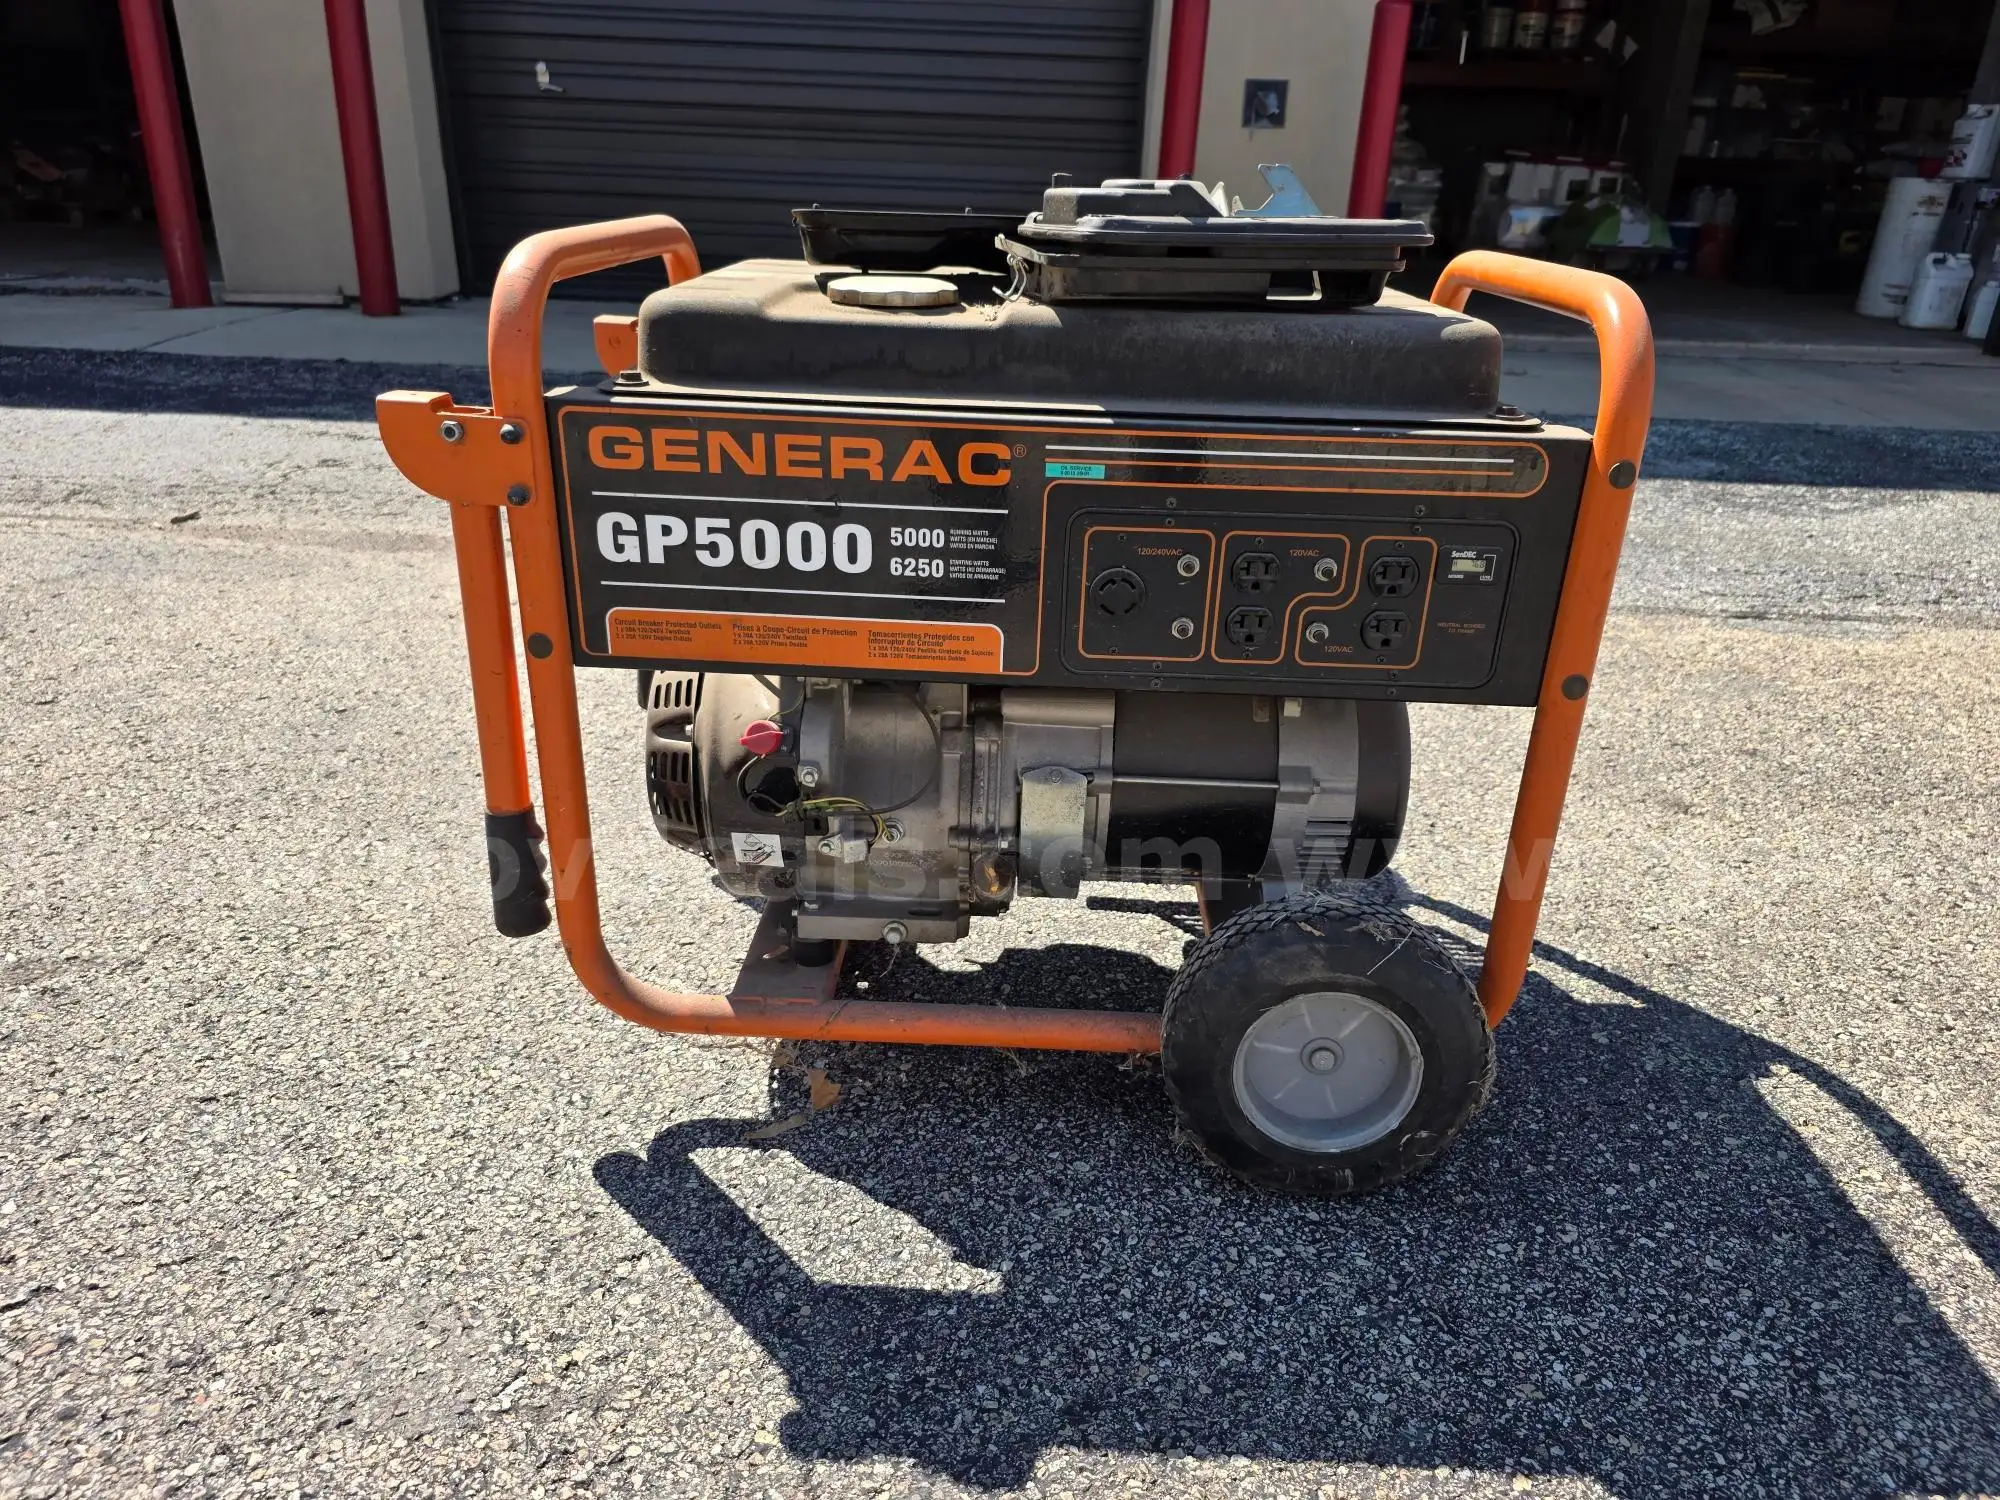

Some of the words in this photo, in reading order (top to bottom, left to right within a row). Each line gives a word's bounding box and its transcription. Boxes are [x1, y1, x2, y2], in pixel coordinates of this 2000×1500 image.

[597, 511, 873, 574] GP5000
[890, 527, 945, 548] 5000
[1137, 548, 1184, 556] 120/240VAC
[890, 557, 944, 578] 6250
[614, 618, 636, 626] Circuit
[638, 619, 664, 627] Breaker
[666, 620, 697, 628] Protected
[733, 624, 754, 632] Prises
[762, 625, 810, 635] Coupe-Circuit
[822, 628, 858, 636] Protection
[868, 630, 922, 640] Tomacorrientes
[923, 632, 960, 642] Protegidos
[868, 637, 904, 646] Interruptor
[917, 639, 944, 648] Circuito
